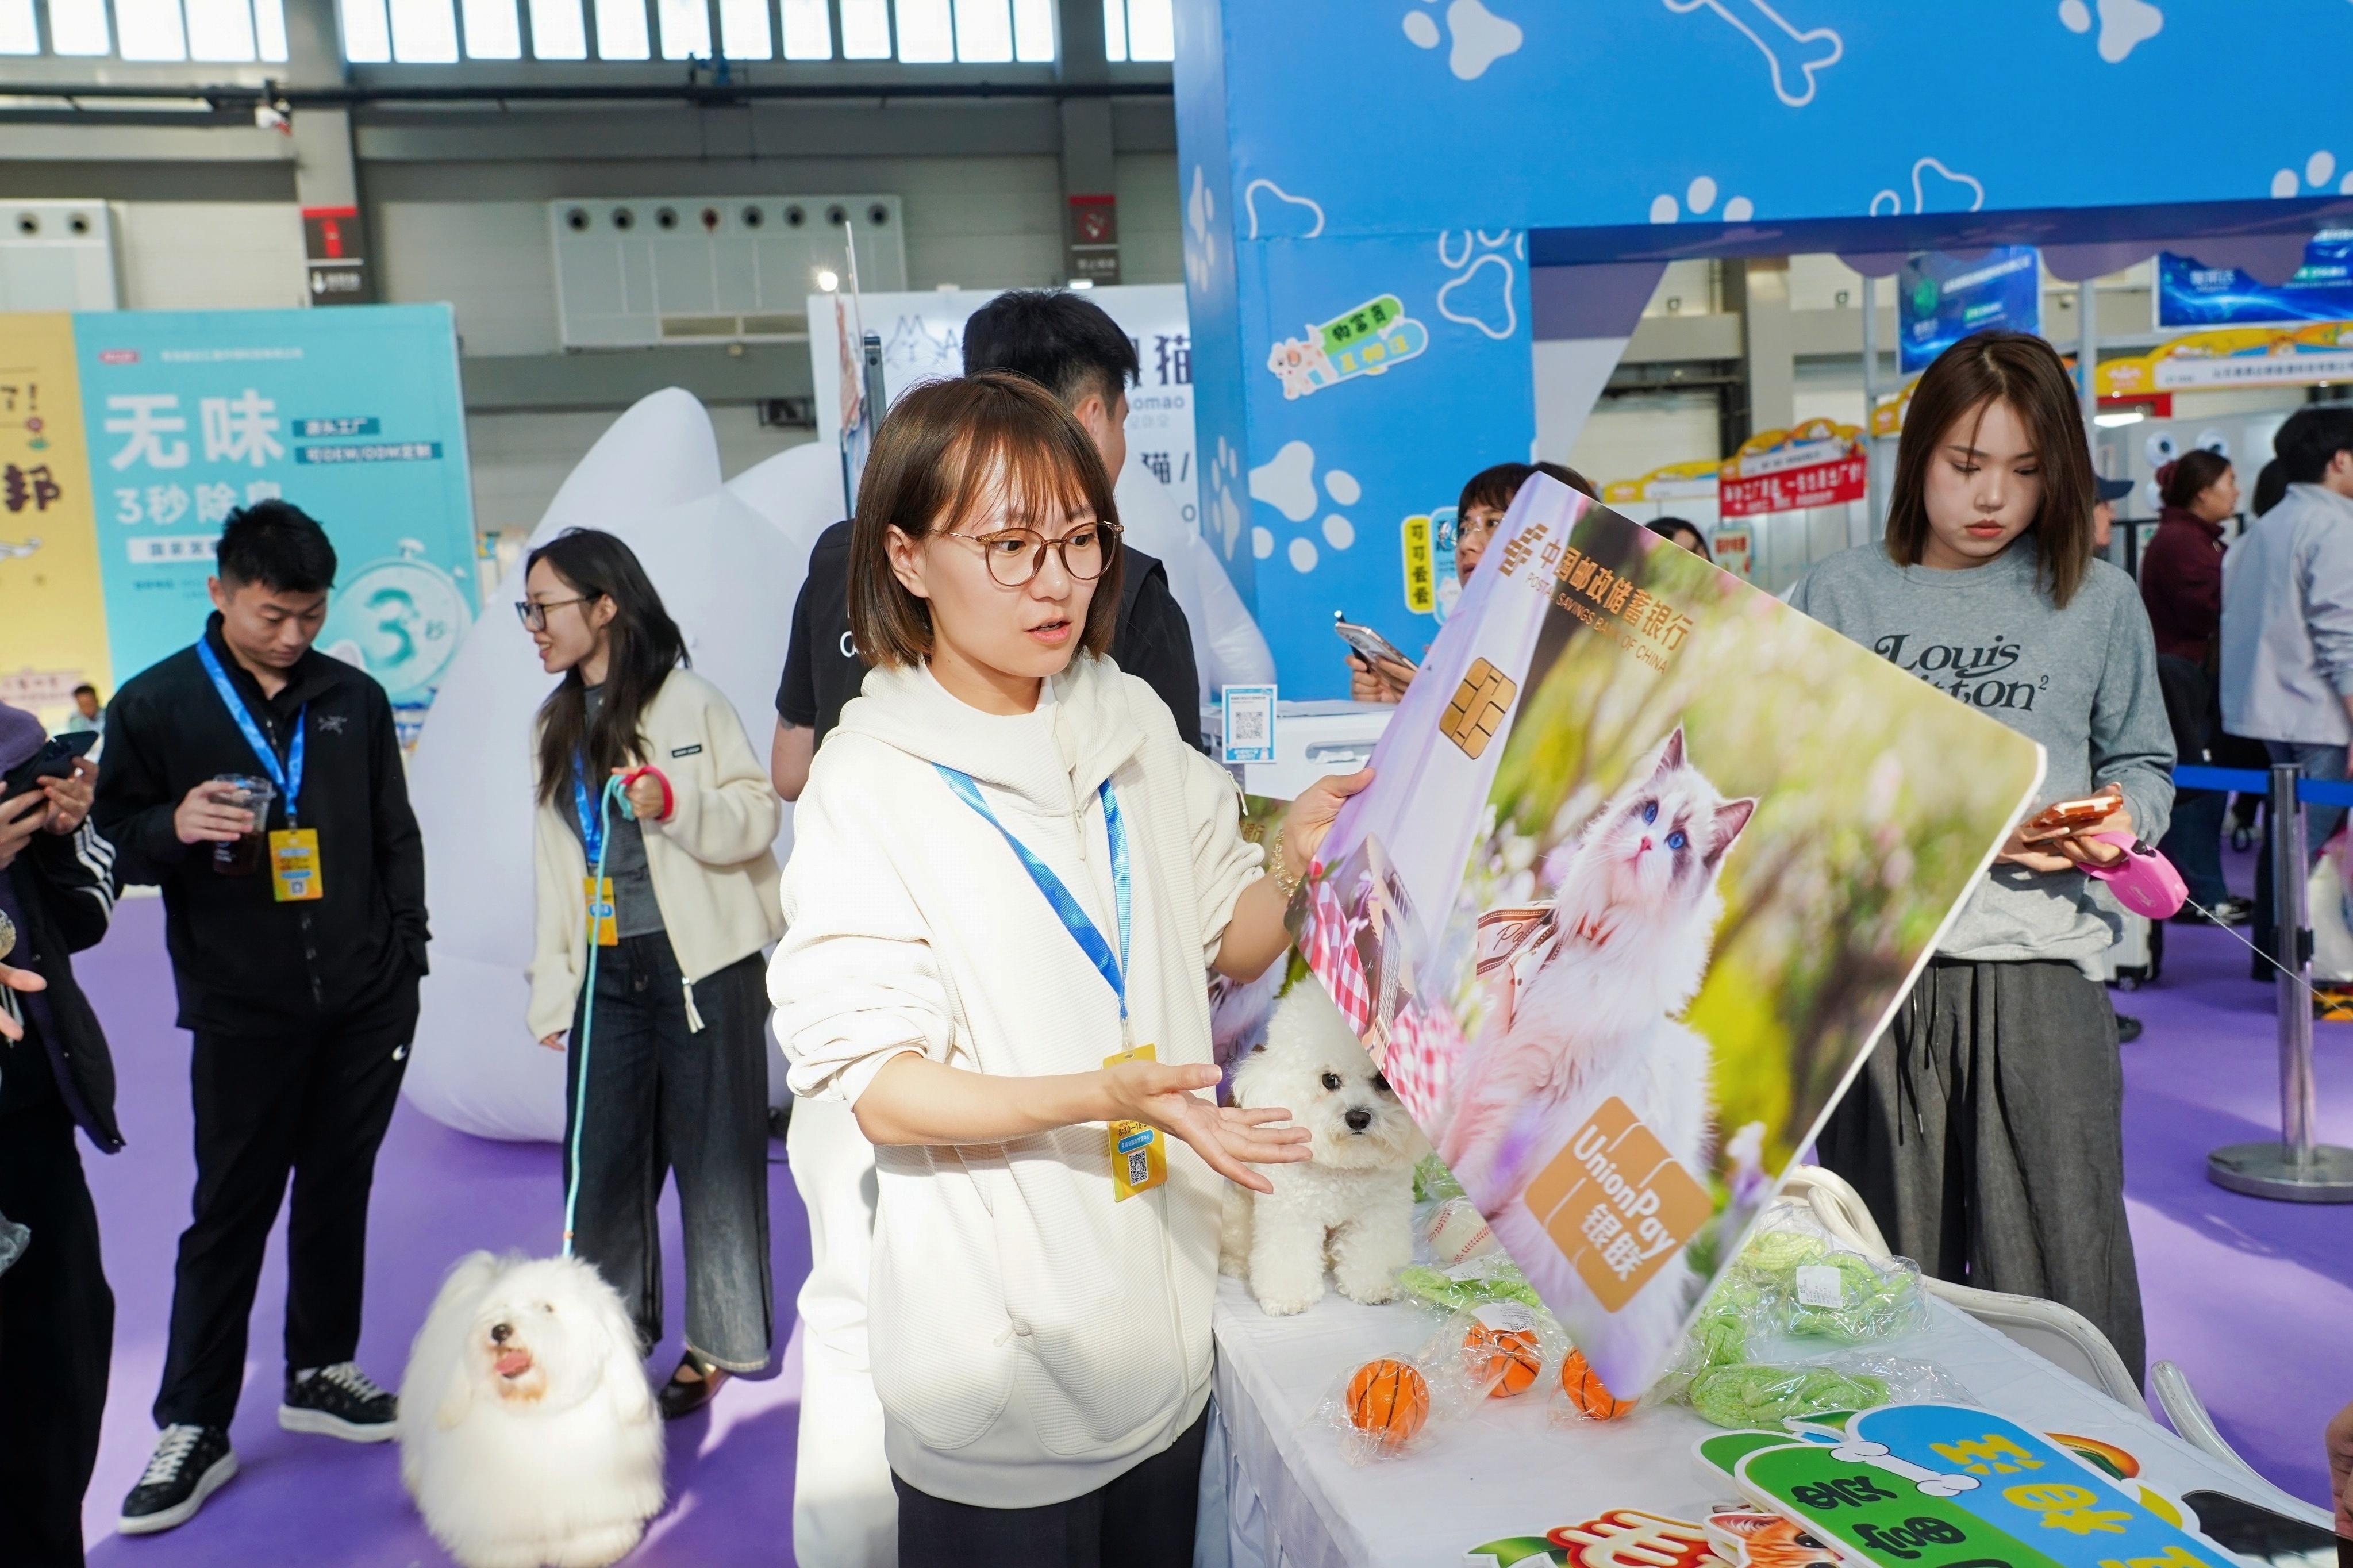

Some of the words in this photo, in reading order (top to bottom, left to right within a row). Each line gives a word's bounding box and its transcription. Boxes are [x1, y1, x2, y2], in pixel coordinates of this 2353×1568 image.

[1122, 335, 1193, 386] 猫
[1129, 395, 1185, 410] omao
[104, 387, 284, 472] 无味
[1525, 572, 1555, 601] POSTAL
[1556, 592, 1597, 625] SAVINGS
[1594, 616, 1618, 641] BANK
[1621, 634, 1637, 652] OF
[1635, 645, 1670, 674] CHINA
[1540, 538, 1694, 651] 中国邮政储蓄银行
[1874, 635, 2021, 678] Louis
[1572, 1124, 1677, 1260] UnionPay
[1580, 1202, 1643, 1281] 银联
[1791, 1475, 2013, 1568] 富贵
